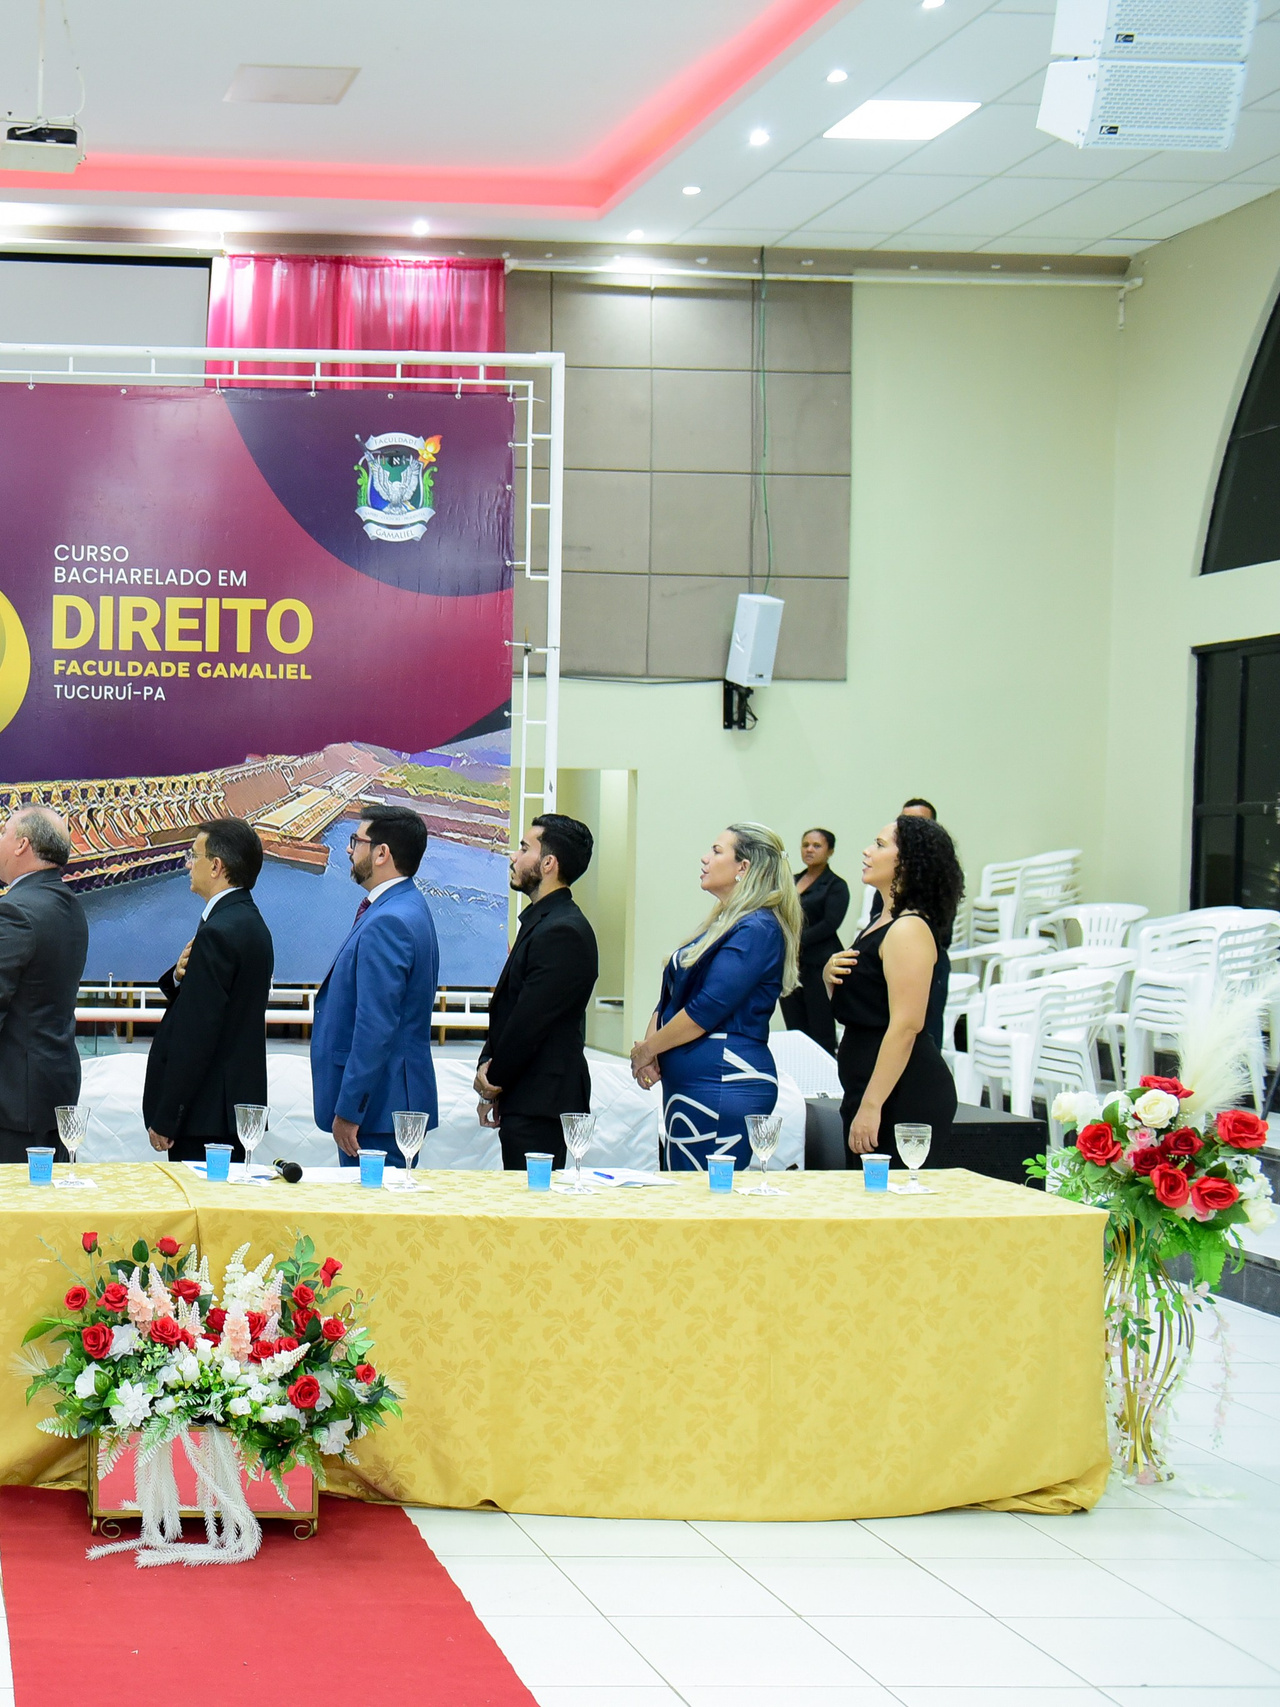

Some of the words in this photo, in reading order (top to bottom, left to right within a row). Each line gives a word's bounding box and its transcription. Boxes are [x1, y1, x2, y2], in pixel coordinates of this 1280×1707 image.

[375, 528, 415, 540] GAMALIEL
[53, 544, 130, 563] CURSO
[53, 566, 211, 586] BACHARELADO
[218, 570, 248, 588] EM
[52, 594, 314, 655] DIREITO
[53, 658, 190, 679] FACULDADE
[196, 661, 313, 680] GAMALIEL
[53, 681, 167, 701] TUCURUÍ-PA
